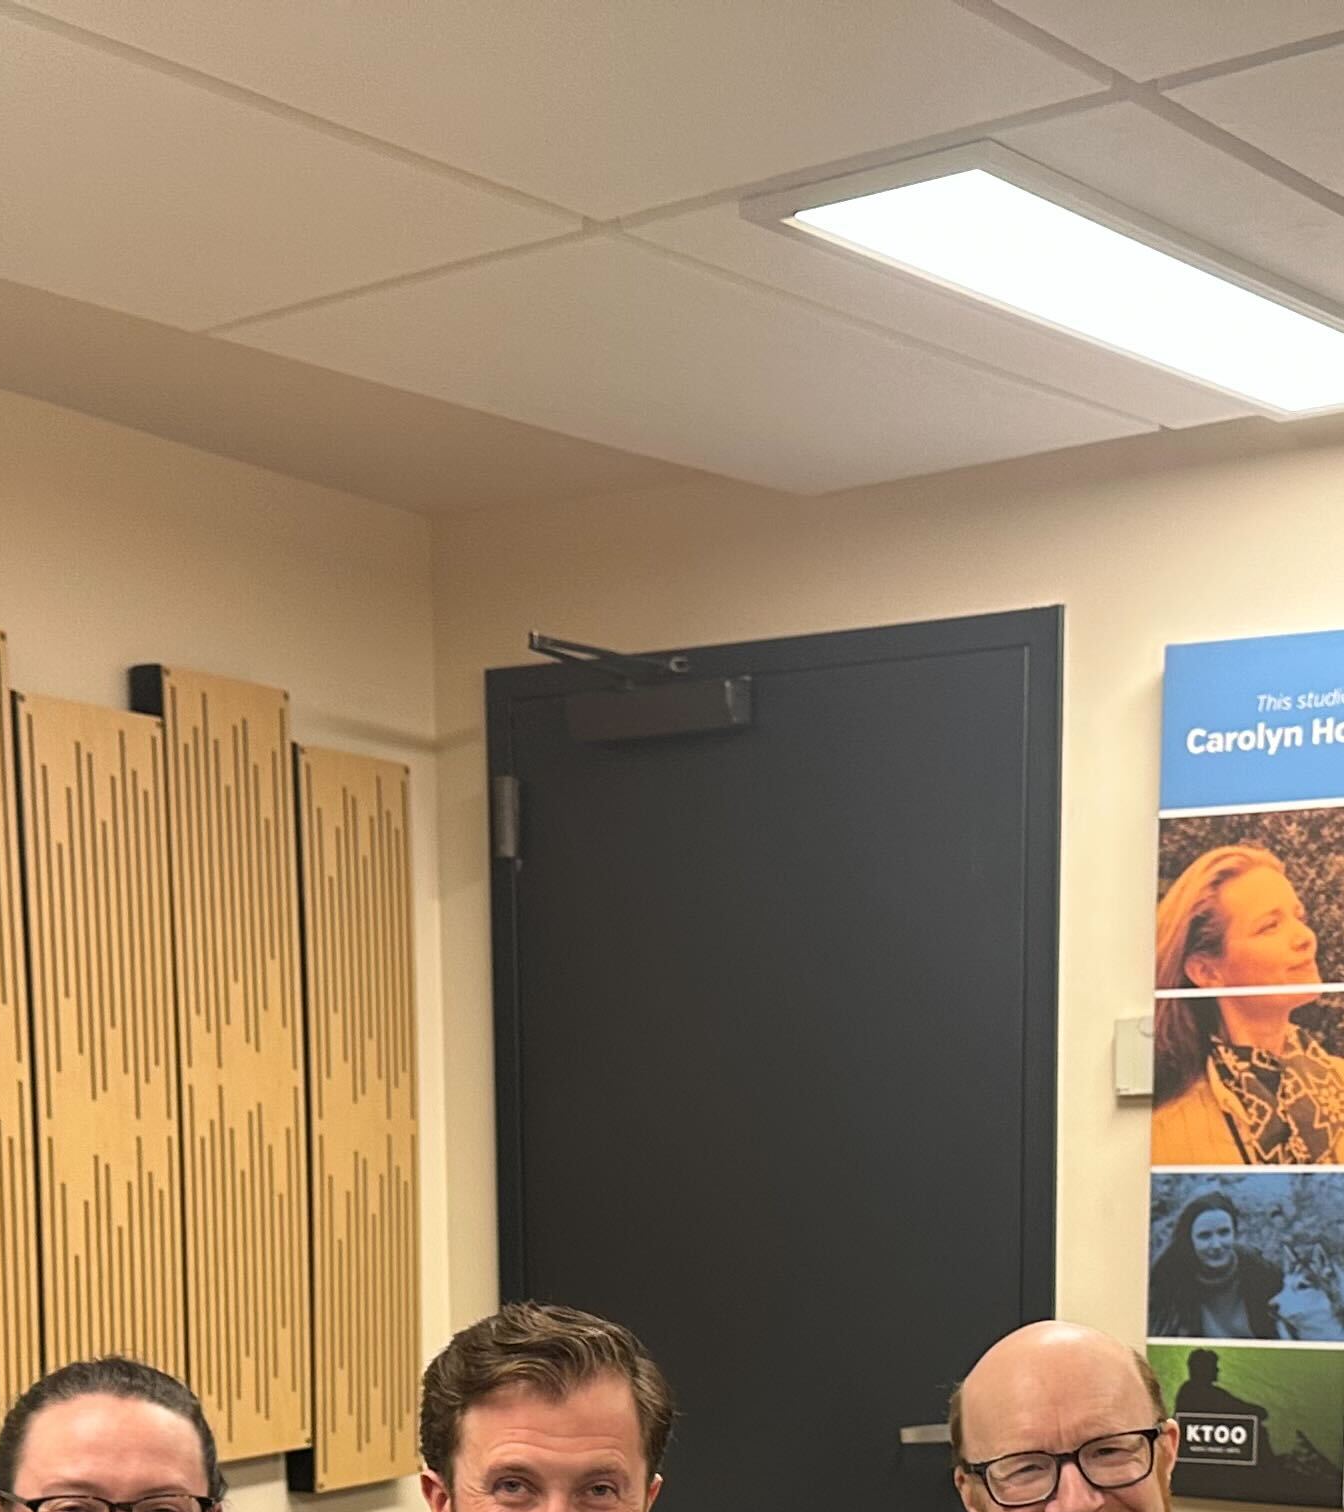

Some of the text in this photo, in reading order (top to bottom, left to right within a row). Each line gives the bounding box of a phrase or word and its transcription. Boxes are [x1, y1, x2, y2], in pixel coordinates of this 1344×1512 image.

[1256, 694, 1292, 712] This
[1186, 722, 1302, 755] Carolyn
[1186, 1424, 1247, 1445] KTOO
